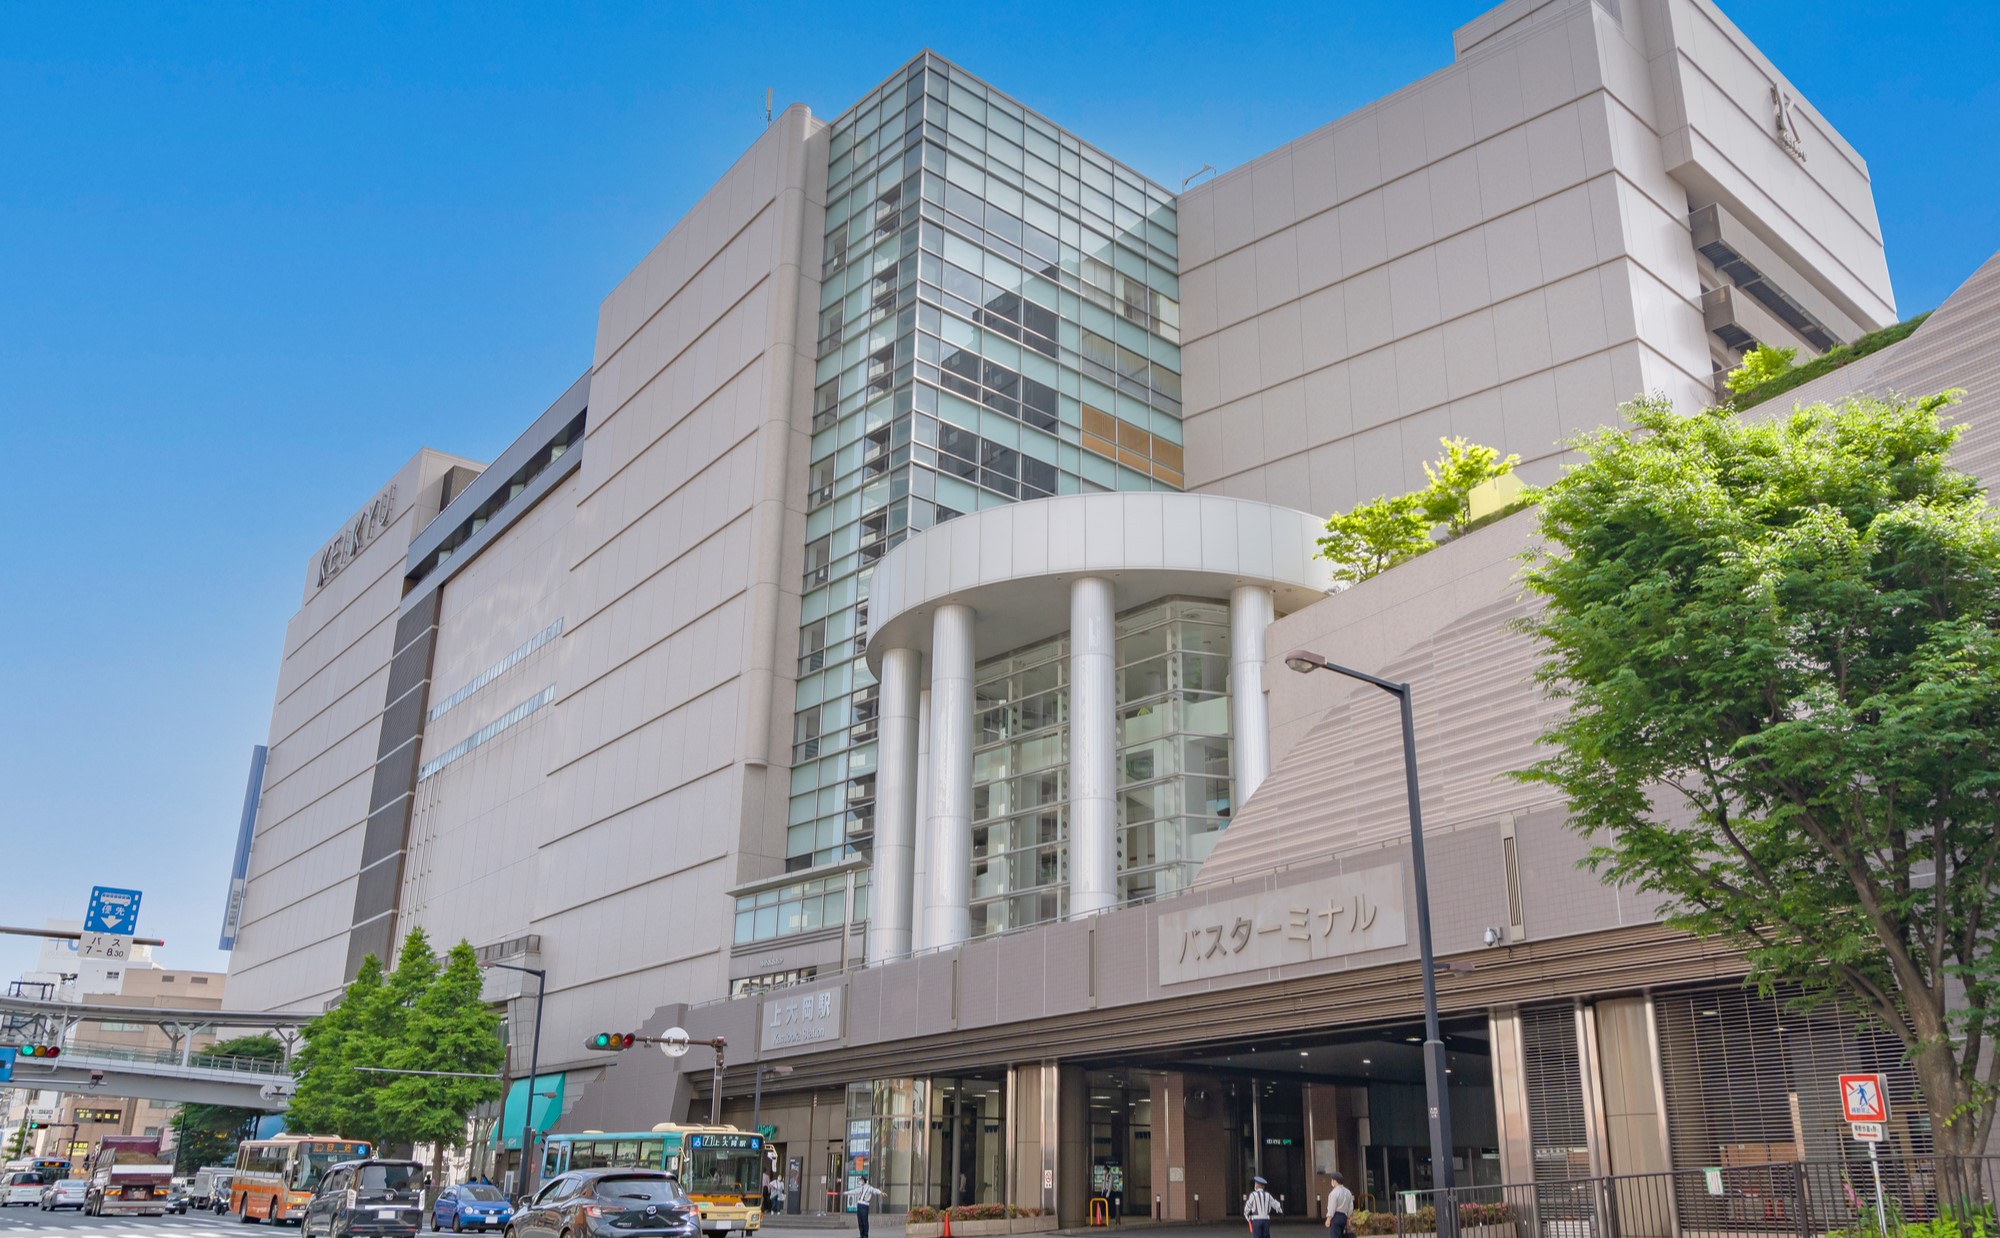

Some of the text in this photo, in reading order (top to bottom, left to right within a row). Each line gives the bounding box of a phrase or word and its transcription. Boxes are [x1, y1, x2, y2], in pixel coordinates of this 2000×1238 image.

[316, 483, 397, 588] KEIKYU
[101, 904, 126, 917] 優先
[227, 890, 241, 926] KEIKYU
[91, 936, 121, 948] バス
[1179, 893, 1378, 965] バスターミナル
[770, 992, 831, 1029] 上大岡駅
[803, 1028, 825, 1041] Station
